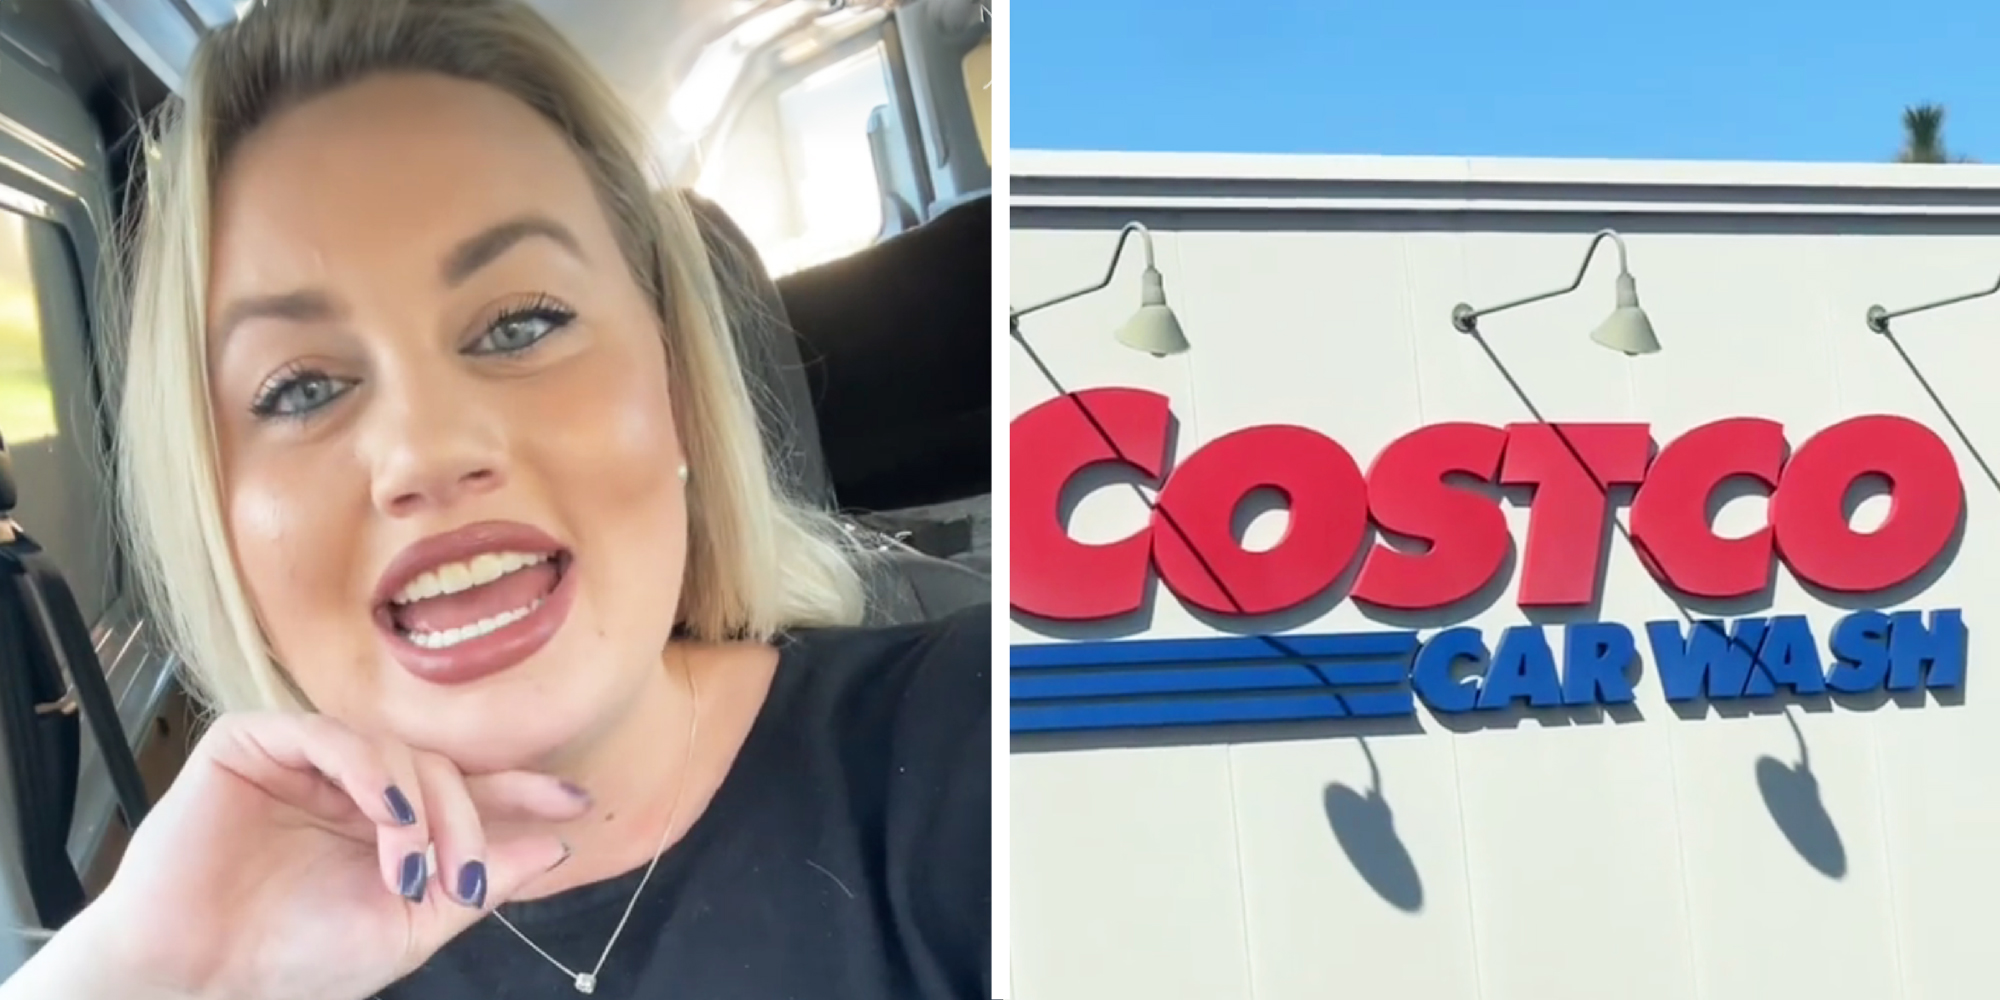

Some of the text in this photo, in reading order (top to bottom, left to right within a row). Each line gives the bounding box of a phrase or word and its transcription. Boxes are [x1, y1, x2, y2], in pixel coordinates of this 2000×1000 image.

[1010, 387, 1962, 620] COSTCO
[1413, 608, 1962, 712] CAR WASH
